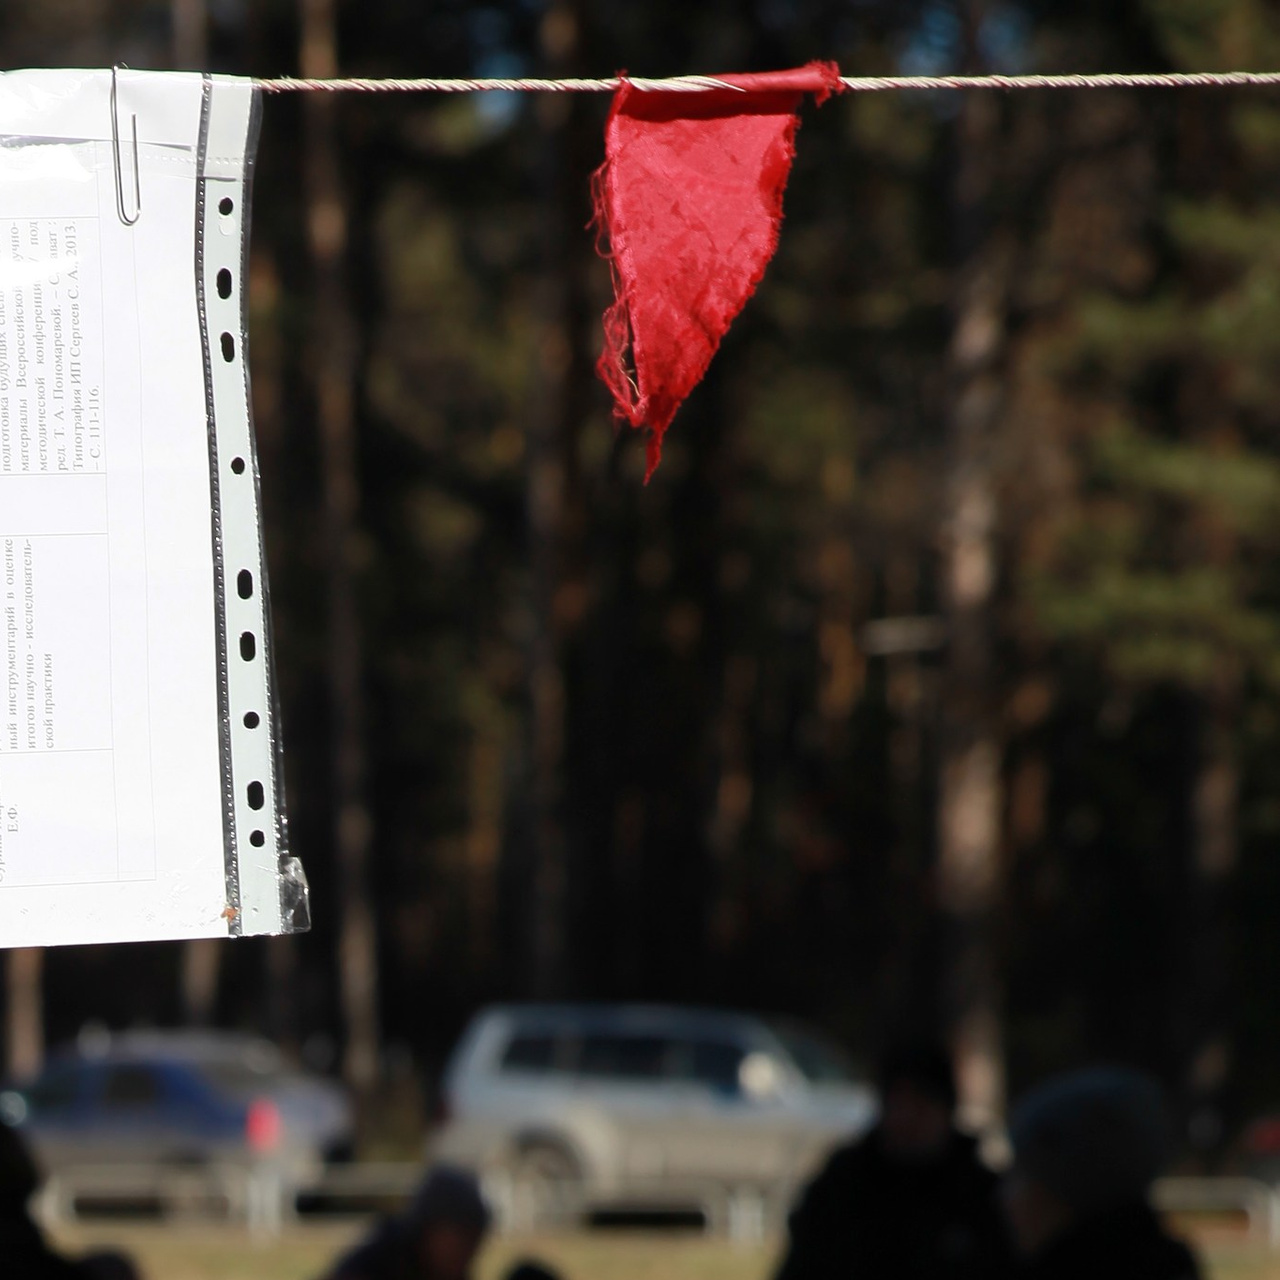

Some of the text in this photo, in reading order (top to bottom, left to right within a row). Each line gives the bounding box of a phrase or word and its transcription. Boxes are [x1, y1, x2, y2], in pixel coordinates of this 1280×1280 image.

[64, 221, 77, 255] 2013.
[67, 266, 78, 280] А.,
[10, 222, 31, 471] материалы Всероссийской учно-
[29, 221, 48, 471] методической конференци под
[50, 304, 64, 400] Пономаревой.
[69, 303, 82, 358] Сергеев
[0, 396, 12, 472] подготовка
[70, 389, 85, 471] Типография
[88, 385, 100, 438] 111-116.
[57, 444, 69, 471] ред.
[5, 539, 15, 586] оценке
[4, 606, 19, 716] инструментарий
[23, 539, 38, 749] итогов научно исследователь-
[42, 653, 56, 749] ской практики
[6, 723, 18, 749] ный
[7, 804, 19, 832] Е.Ф.
